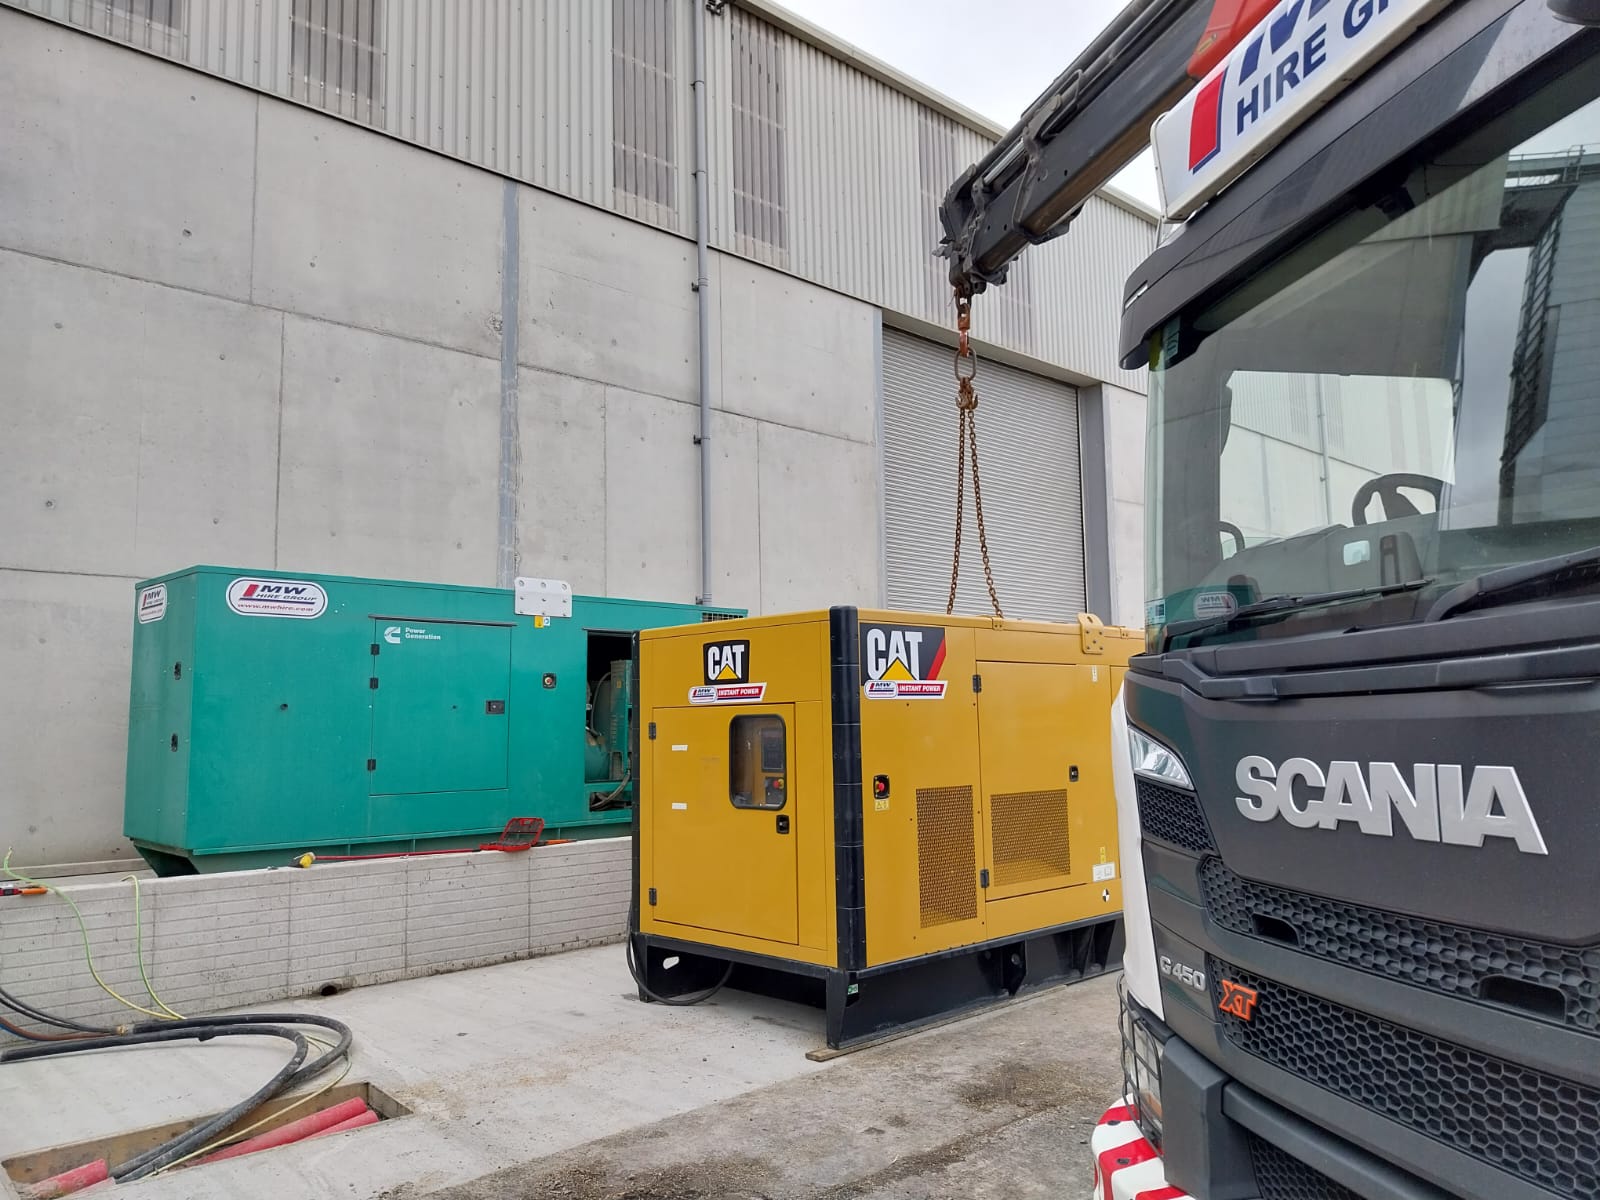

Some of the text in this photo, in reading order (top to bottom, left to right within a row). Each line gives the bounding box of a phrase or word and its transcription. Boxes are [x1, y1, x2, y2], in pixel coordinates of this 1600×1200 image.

[1237, 23, 1327, 136] HIRE
[260, 585, 307, 595] MW
[708, 645, 744, 680] CAT
[867, 629, 922, 680] CAT
[1235, 755, 1549, 855] SCANIA
[1219, 979, 1257, 1021] XT
